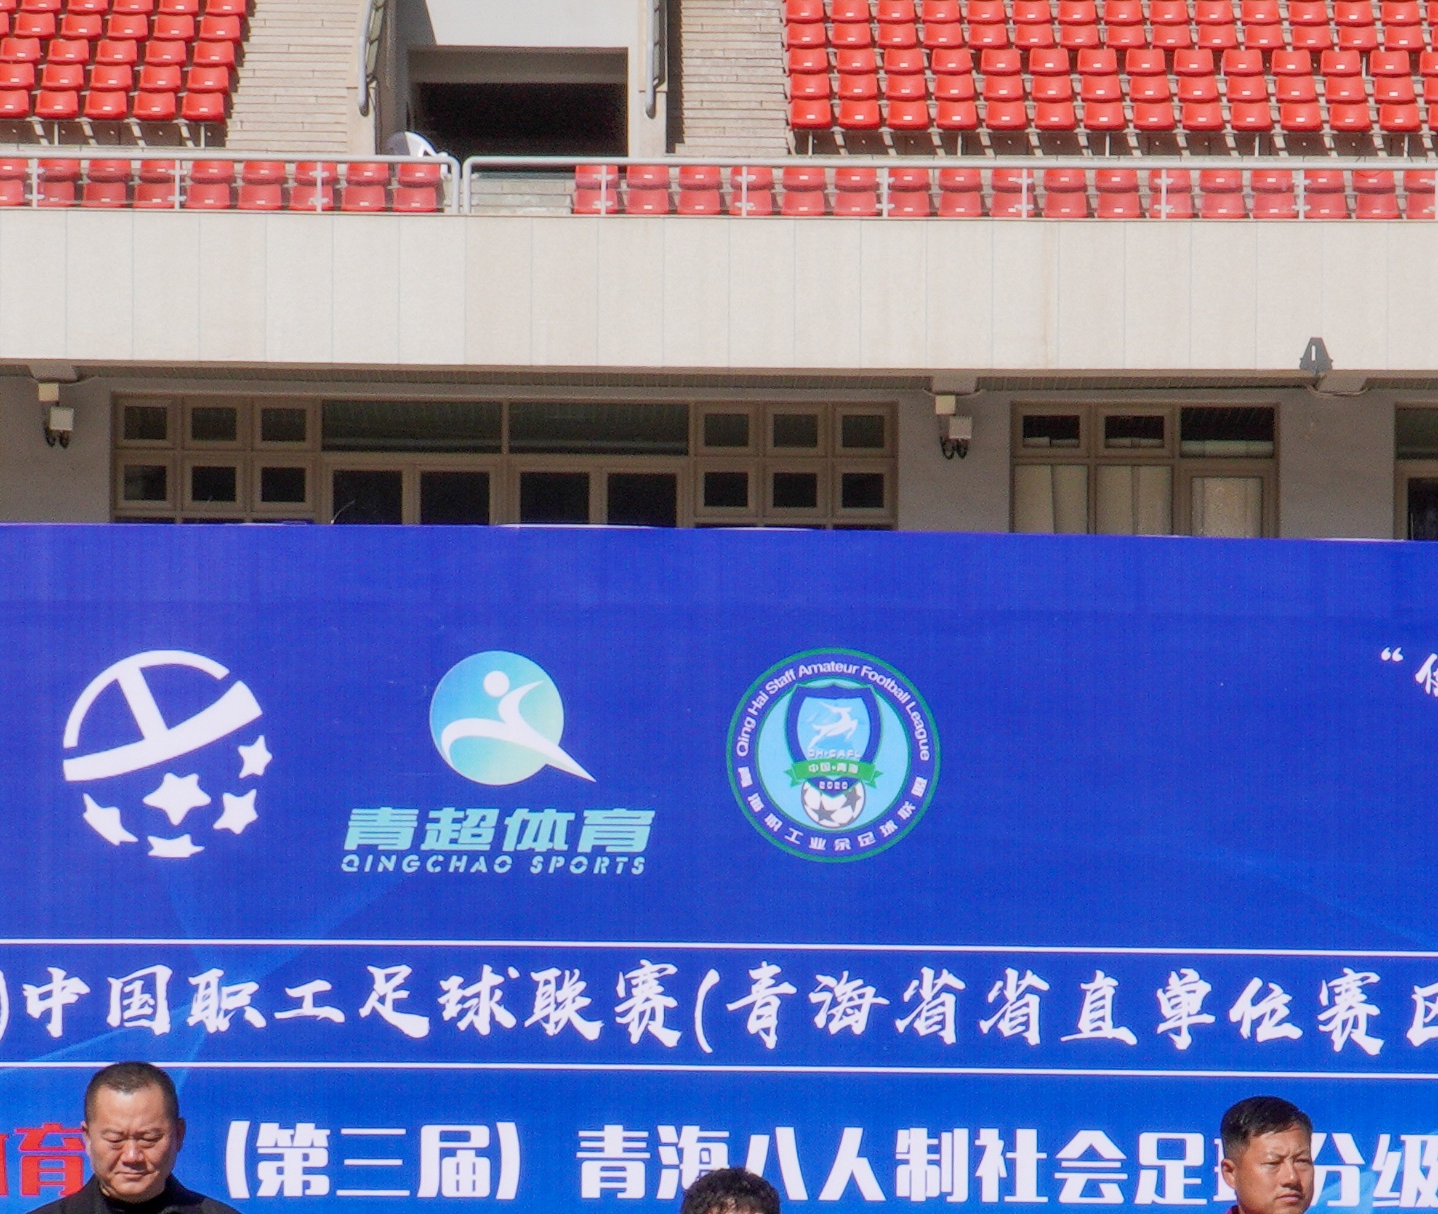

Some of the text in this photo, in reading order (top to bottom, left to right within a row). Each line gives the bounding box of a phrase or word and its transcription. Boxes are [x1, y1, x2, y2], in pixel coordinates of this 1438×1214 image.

[736, 661, 930, 761] Qing Hai Staff Amateur Football League
[344, 807, 656, 853] 青超体育
[341, 854, 646, 875] QINGCHAO SPORTS
